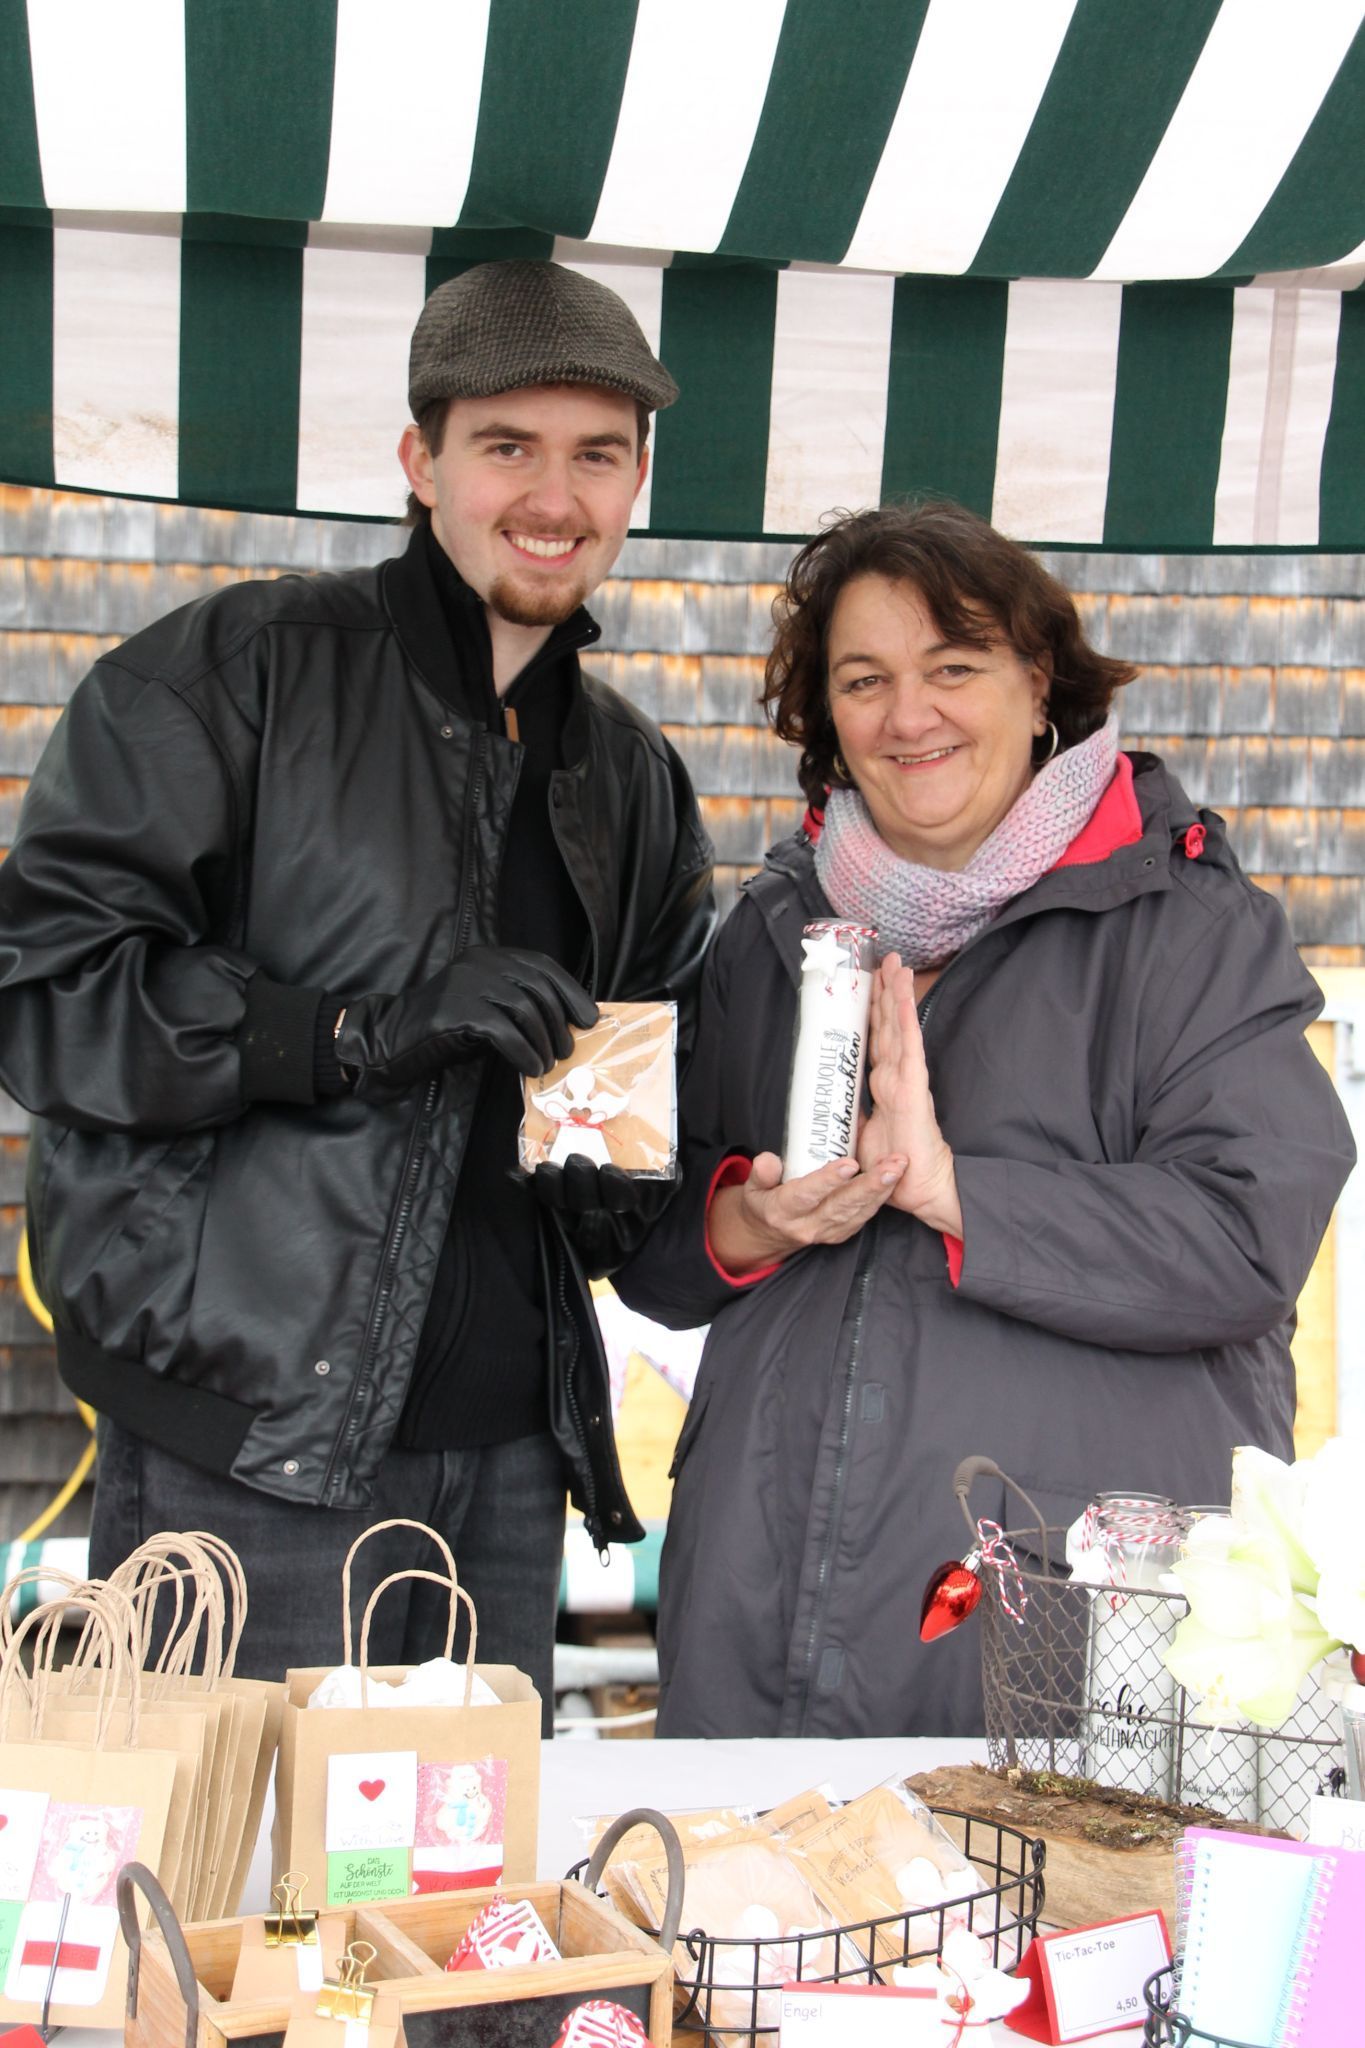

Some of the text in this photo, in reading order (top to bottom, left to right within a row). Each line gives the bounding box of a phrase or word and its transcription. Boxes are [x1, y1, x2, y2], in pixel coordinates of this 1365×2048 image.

[810, 1042, 838, 1147] WUNDERVOLLE
[1055, 1940, 1116, 1962] Tic-Tac-Toe
[784, 2000, 823, 2022] Engel
[1116, 1996, 1138, 2013] 4,50
